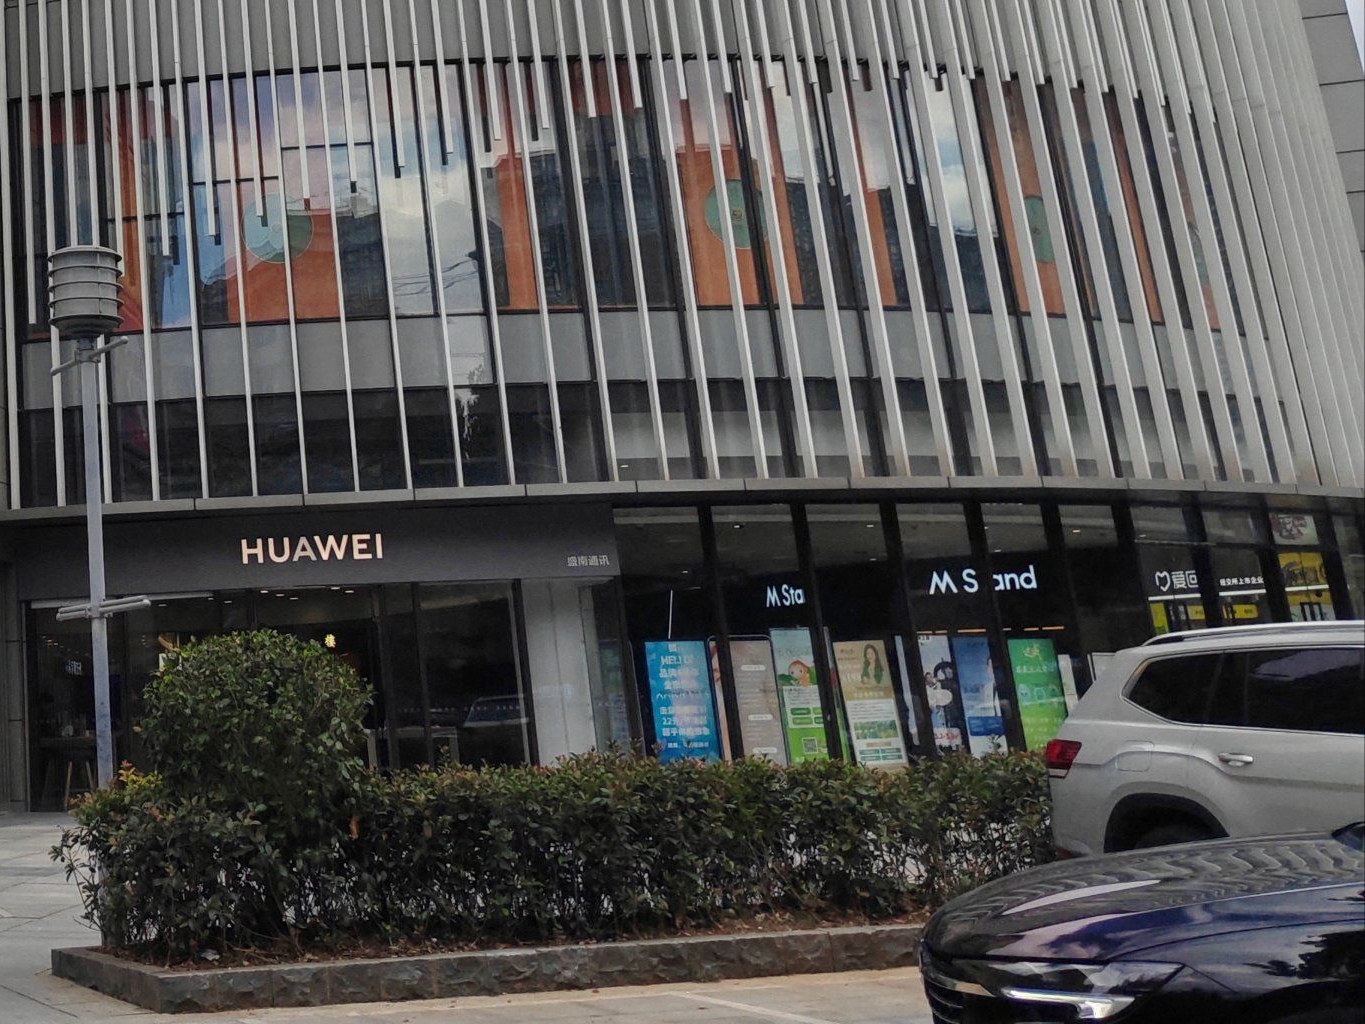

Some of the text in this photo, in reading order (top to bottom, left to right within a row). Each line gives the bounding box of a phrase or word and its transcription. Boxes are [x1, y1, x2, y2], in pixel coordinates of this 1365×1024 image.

[240, 532, 384, 565] HUAWEI
[928, 564, 1038, 595] M Sand
[766, 585, 781, 608] M
